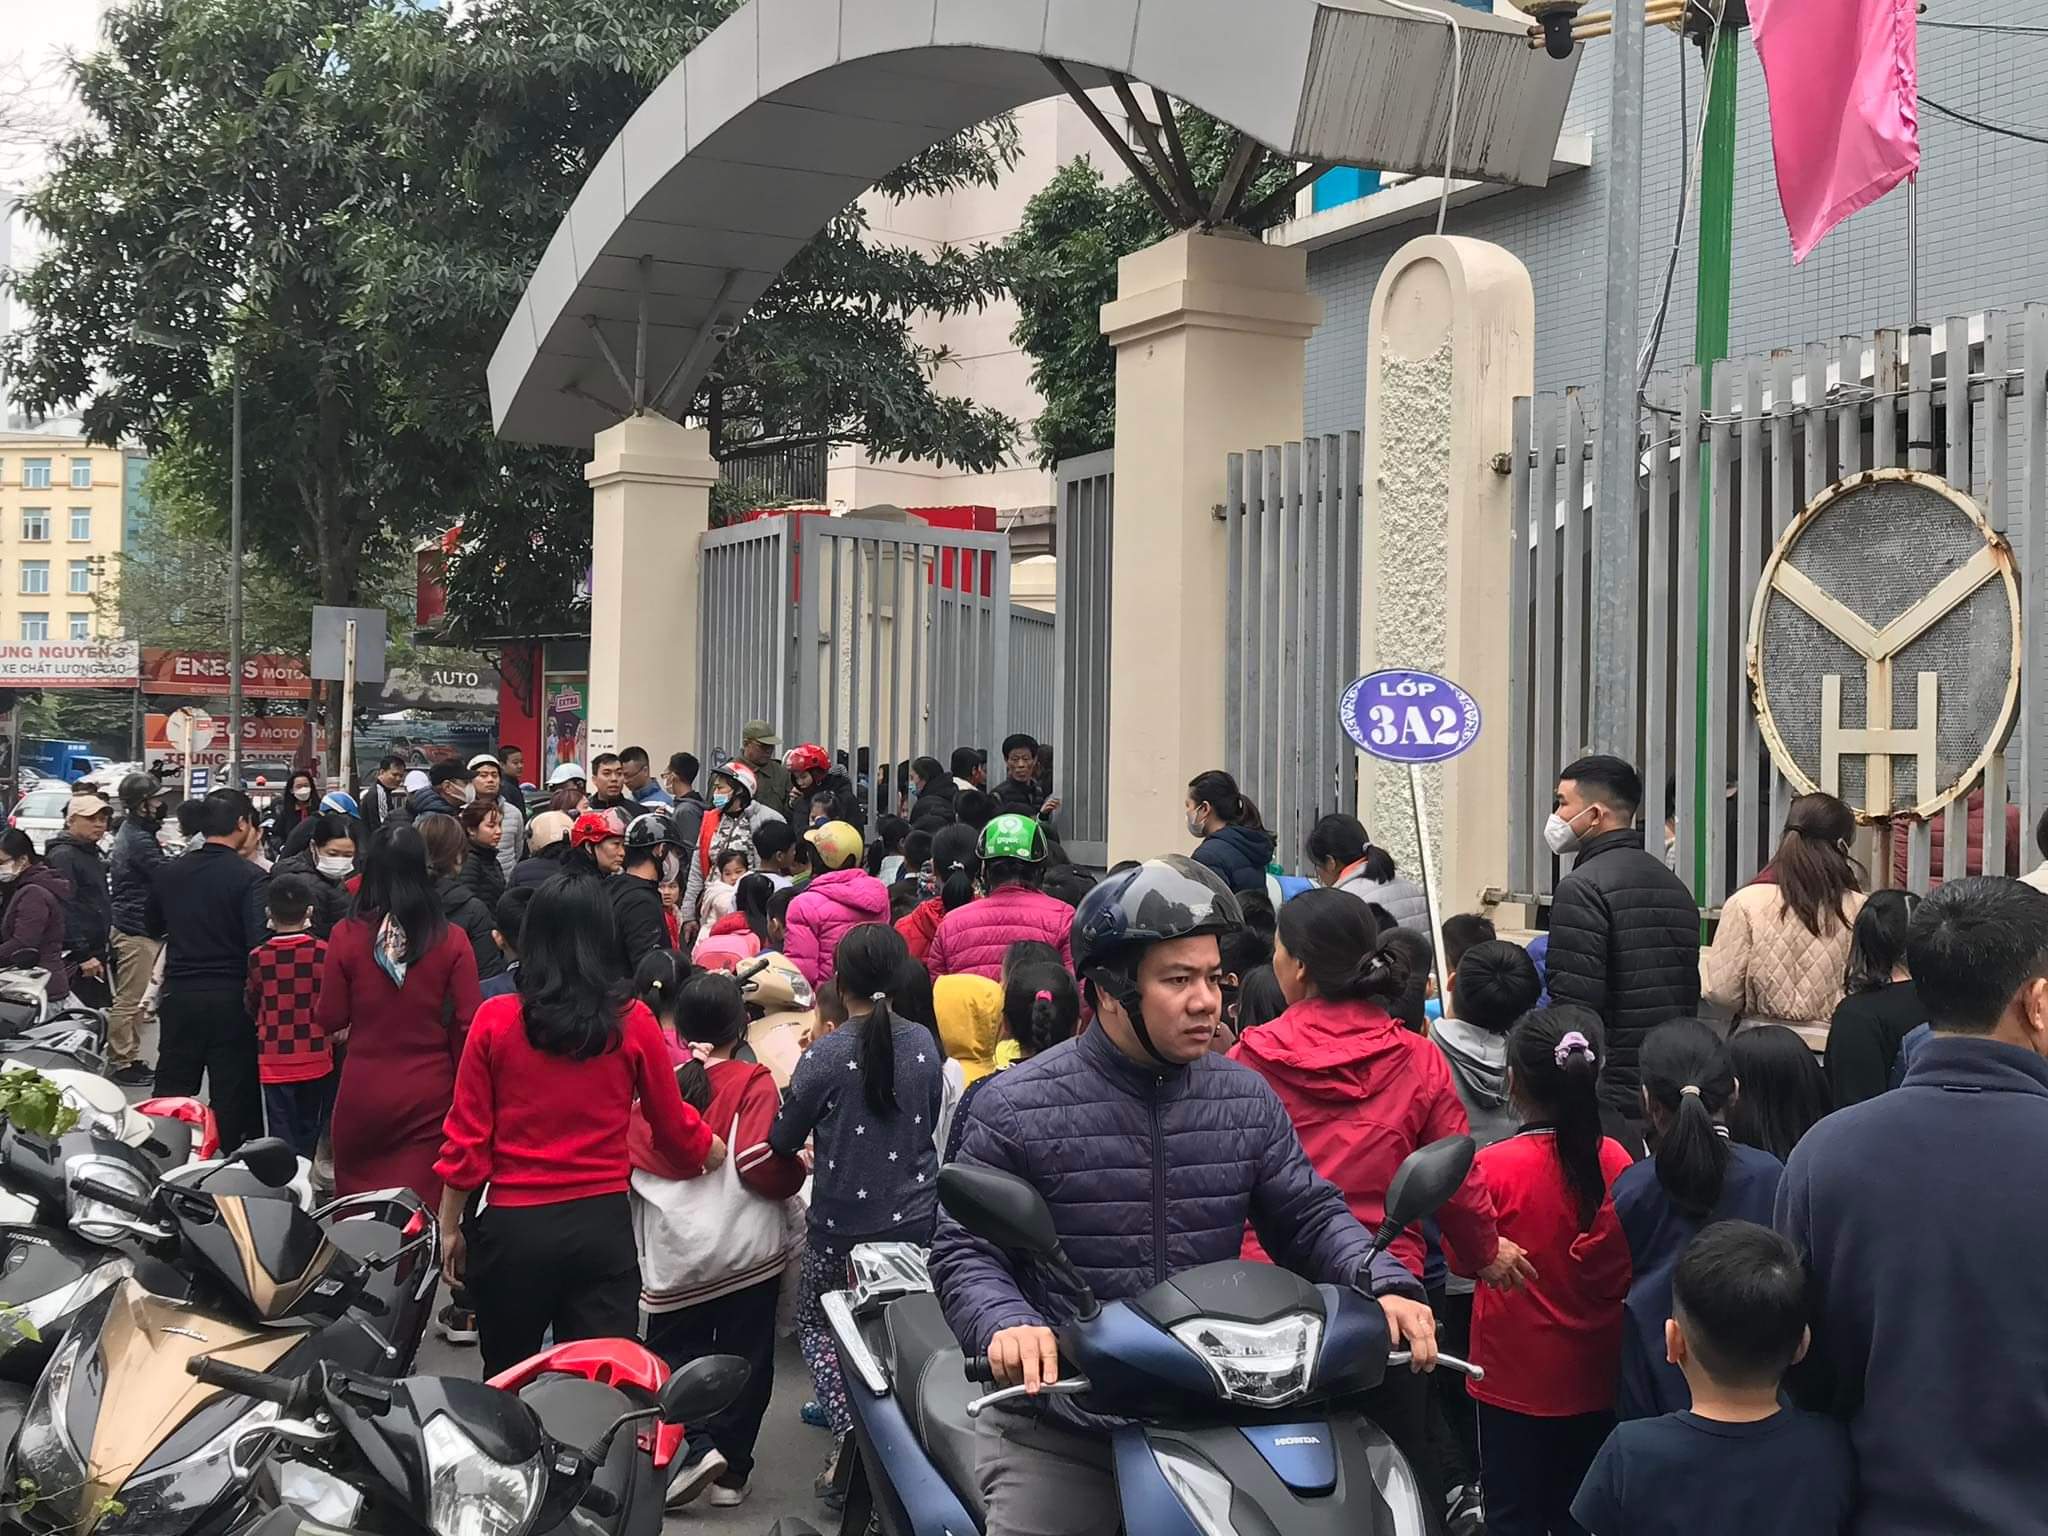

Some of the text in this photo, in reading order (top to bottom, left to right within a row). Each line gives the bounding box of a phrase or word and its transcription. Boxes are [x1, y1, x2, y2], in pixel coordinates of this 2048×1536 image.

[1, 663, 17, 674] XE
[262, 667, 310, 680] MOTO
[431, 671, 479, 686] AUTO
[1379, 678, 1437, 697] LỚP
[1368, 704, 1460, 745] 3A2
[260, 727, 302, 739] MOTO
[7, 1232, 51, 1247] HONDA
[1274, 1436, 1321, 1446] HONDA
